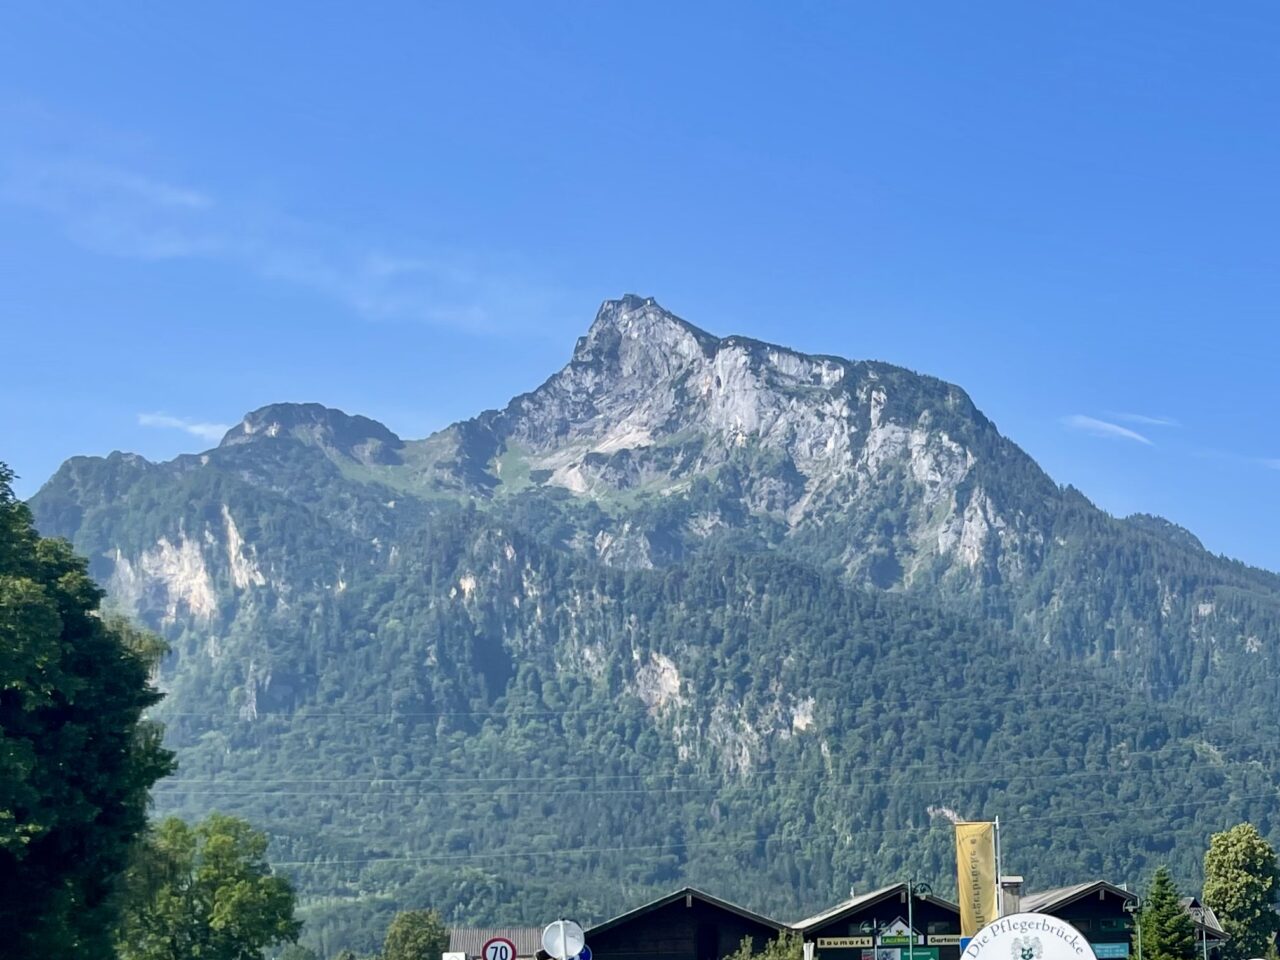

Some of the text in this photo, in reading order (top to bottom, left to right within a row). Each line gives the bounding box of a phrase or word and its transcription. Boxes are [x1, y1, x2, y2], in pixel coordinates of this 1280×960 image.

[820, 938, 870, 946] Baumarkt
[967, 935, 990, 958] Die
[991, 919, 1083, 954] Pflegerbrücke
